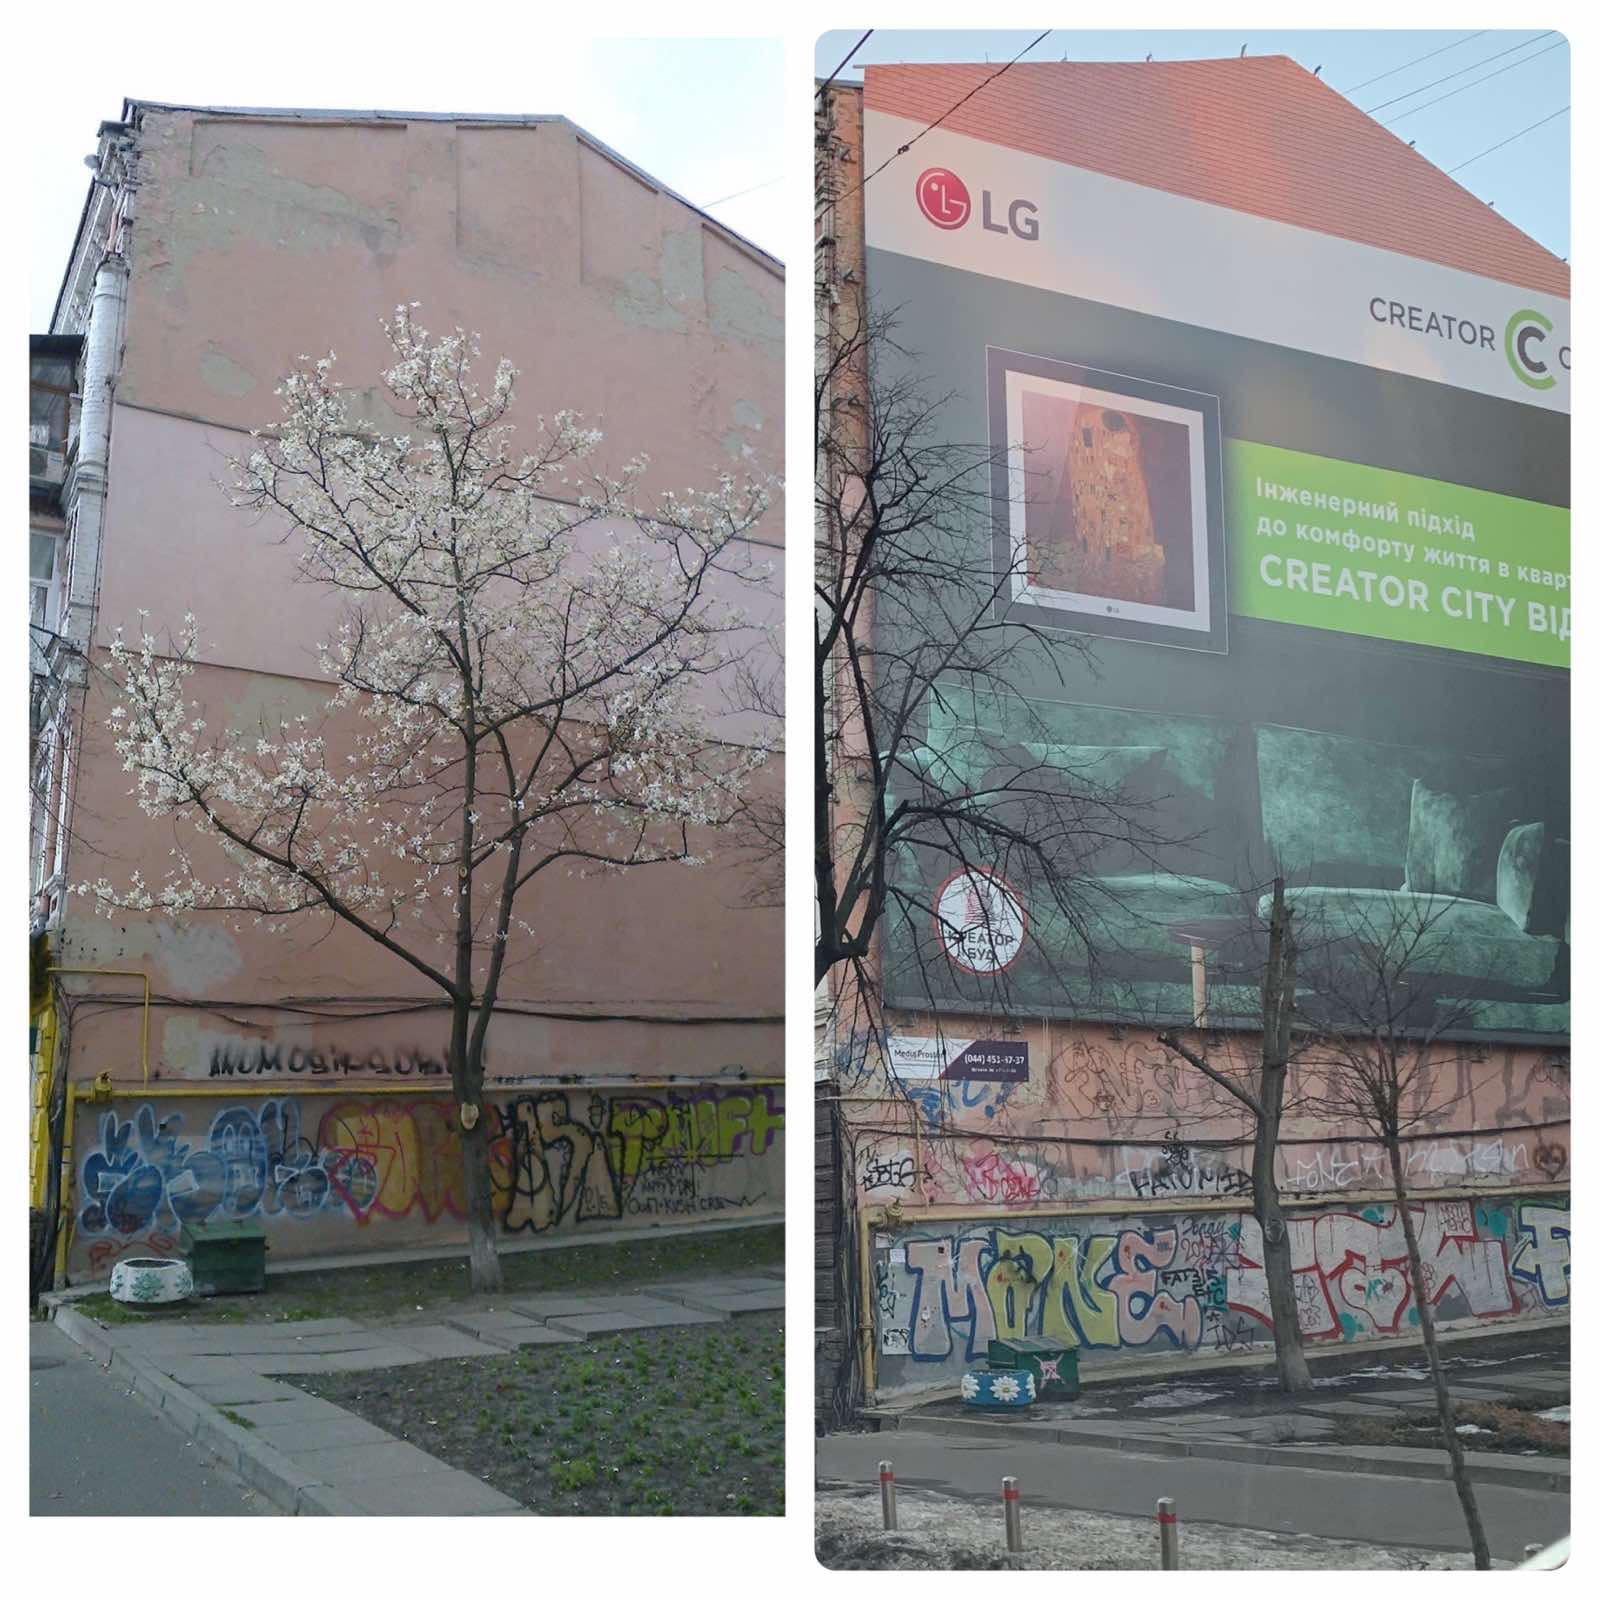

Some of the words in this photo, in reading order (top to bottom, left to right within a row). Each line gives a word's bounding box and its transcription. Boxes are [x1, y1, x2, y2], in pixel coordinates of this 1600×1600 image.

[982, 190, 1039, 241] LG
[1369, 297, 1496, 351] CREATOR
[1256, 477, 1399, 523] Інженерний
[1407, 508, 1476, 542] підхід
[1256, 516, 1287, 537] до
[1295, 521, 1415, 562] комфорту
[1423, 545, 1490, 574] життя
[1498, 561, 1510, 578] в
[1517, 565, 1571, 592] квар
[1259, 554, 1431, 613] CREATOR
[1441, 585, 1517, 627] CITY
[964, 1054, 985, 1065] (044)
